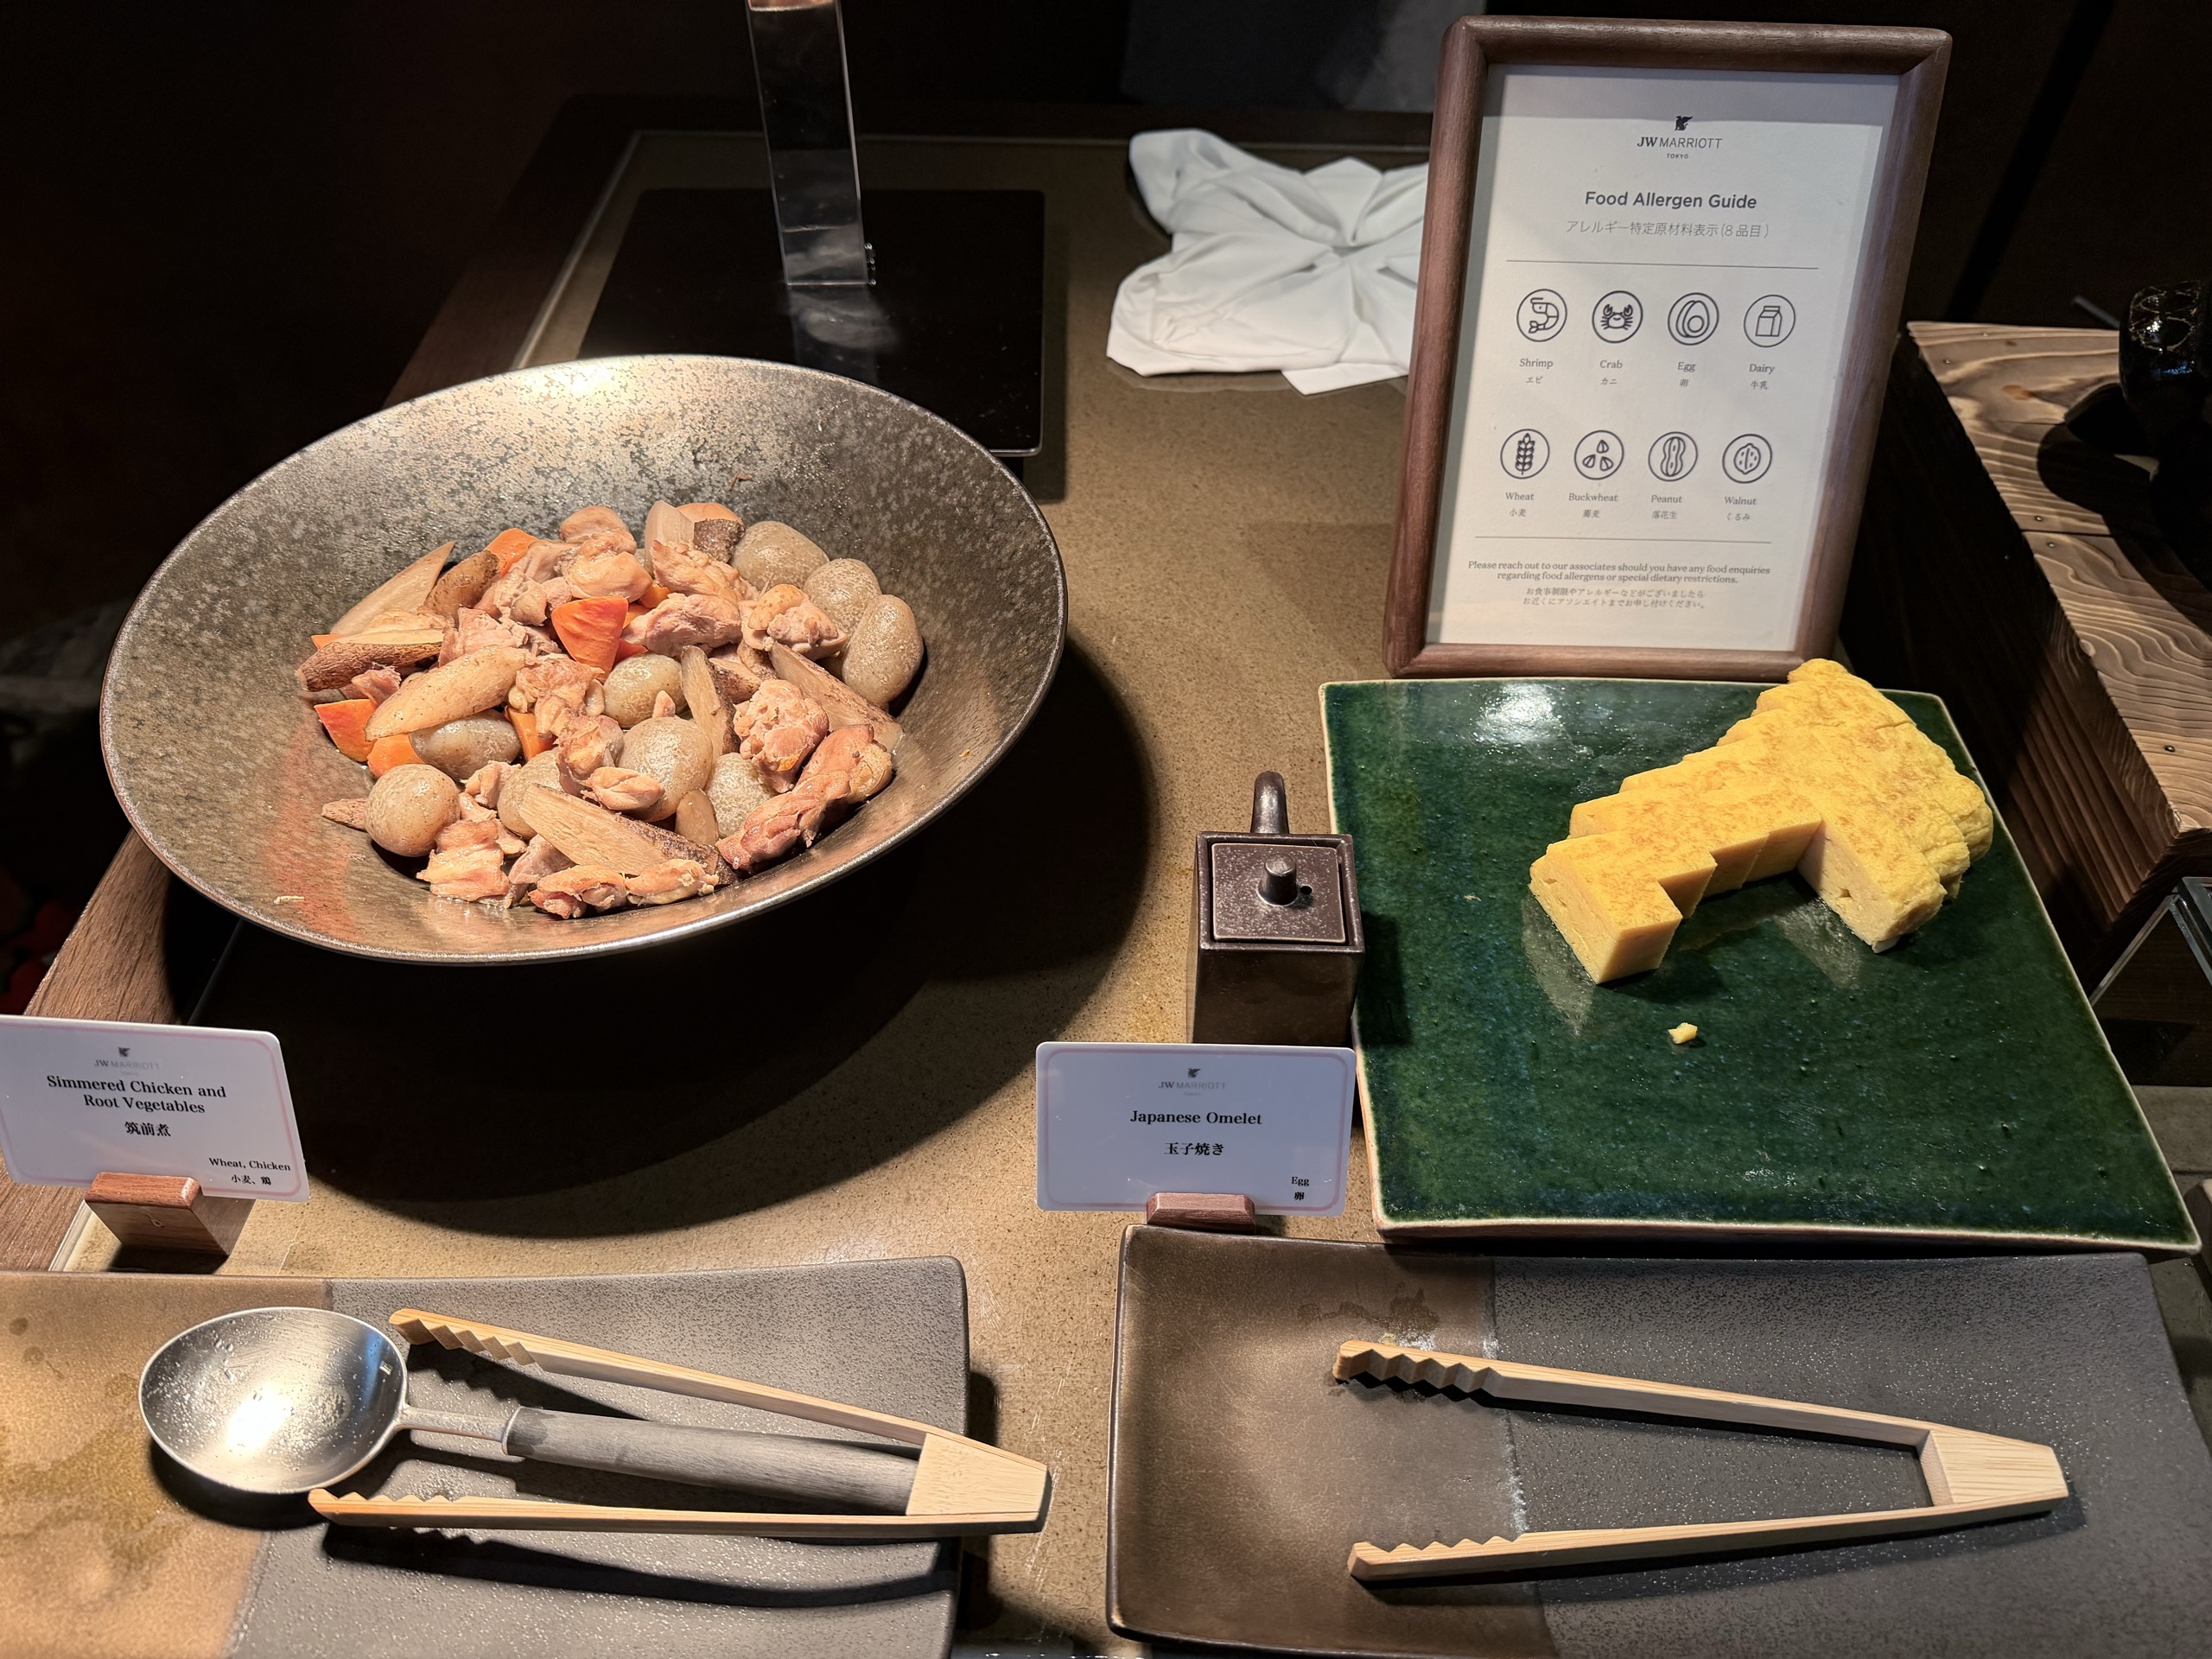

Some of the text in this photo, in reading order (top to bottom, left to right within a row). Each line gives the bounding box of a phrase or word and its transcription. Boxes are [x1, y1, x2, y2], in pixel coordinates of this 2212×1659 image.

[1585, 191, 1758, 210] Food Allergen Guide
[1518, 357, 1554, 370] Shrimp
[1599, 359, 1624, 369] Crab
[1677, 361, 1697, 373] Egg
[1749, 363, 1776, 376] Dairy
[1525, 375, 1544, 385] エビ
[1599, 377, 1618, 386] カニ
[1679, 378, 1689, 388] 卵
[1750, 380, 1769, 391] 牛乳
[1504, 491, 1535, 501] Wheat
[1568, 492, 1618, 502] Buckwheat
[1650, 494, 1683, 504] Peanut
[1724, 496, 1758, 505] Walnut
[1509, 507, 1527, 518] 小麦
[1651, 510, 1678, 520] 落花生
[1726, 512, 1751, 522] くるみ
[1468, 560, 1497, 569] Please
[1498, 561, 1522, 570] reach
[1569, 563, 1617, 571] associates
[1618, 563, 1648, 572] should
[1649, 565, 1666, 575] you
[1667, 563, 1688, 572] have
[1688, 565, 1706, 575] any
[1707, 564, 1727, 573] food
[1728, 565, 1770, 575] enquiries
[1497, 571, 1541, 582] regarding
[1541, 571, 1563, 581] food
[1564, 572, 1605, 582] allergens
[1617, 574, 1649, 583] special
[1650, 574, 1682, 584] dietary
[1683, 575, 1738, 585] restrictions.
[47, 1075, 226, 1098] Simmered Chicken and
[84, 1095, 207, 1114] Root Vegetables
[1129, 1109, 1262, 1125] Japanese Omelet
[124, 1121, 171, 1137] 筑前煮
[1164, 1141, 1224, 1156] 玉子焼き
[208, 1157, 291, 1172] Wheat, Chicken
[1291, 1176, 1310, 1187] Egg
[1294, 1191, 1305, 1201] 卵
